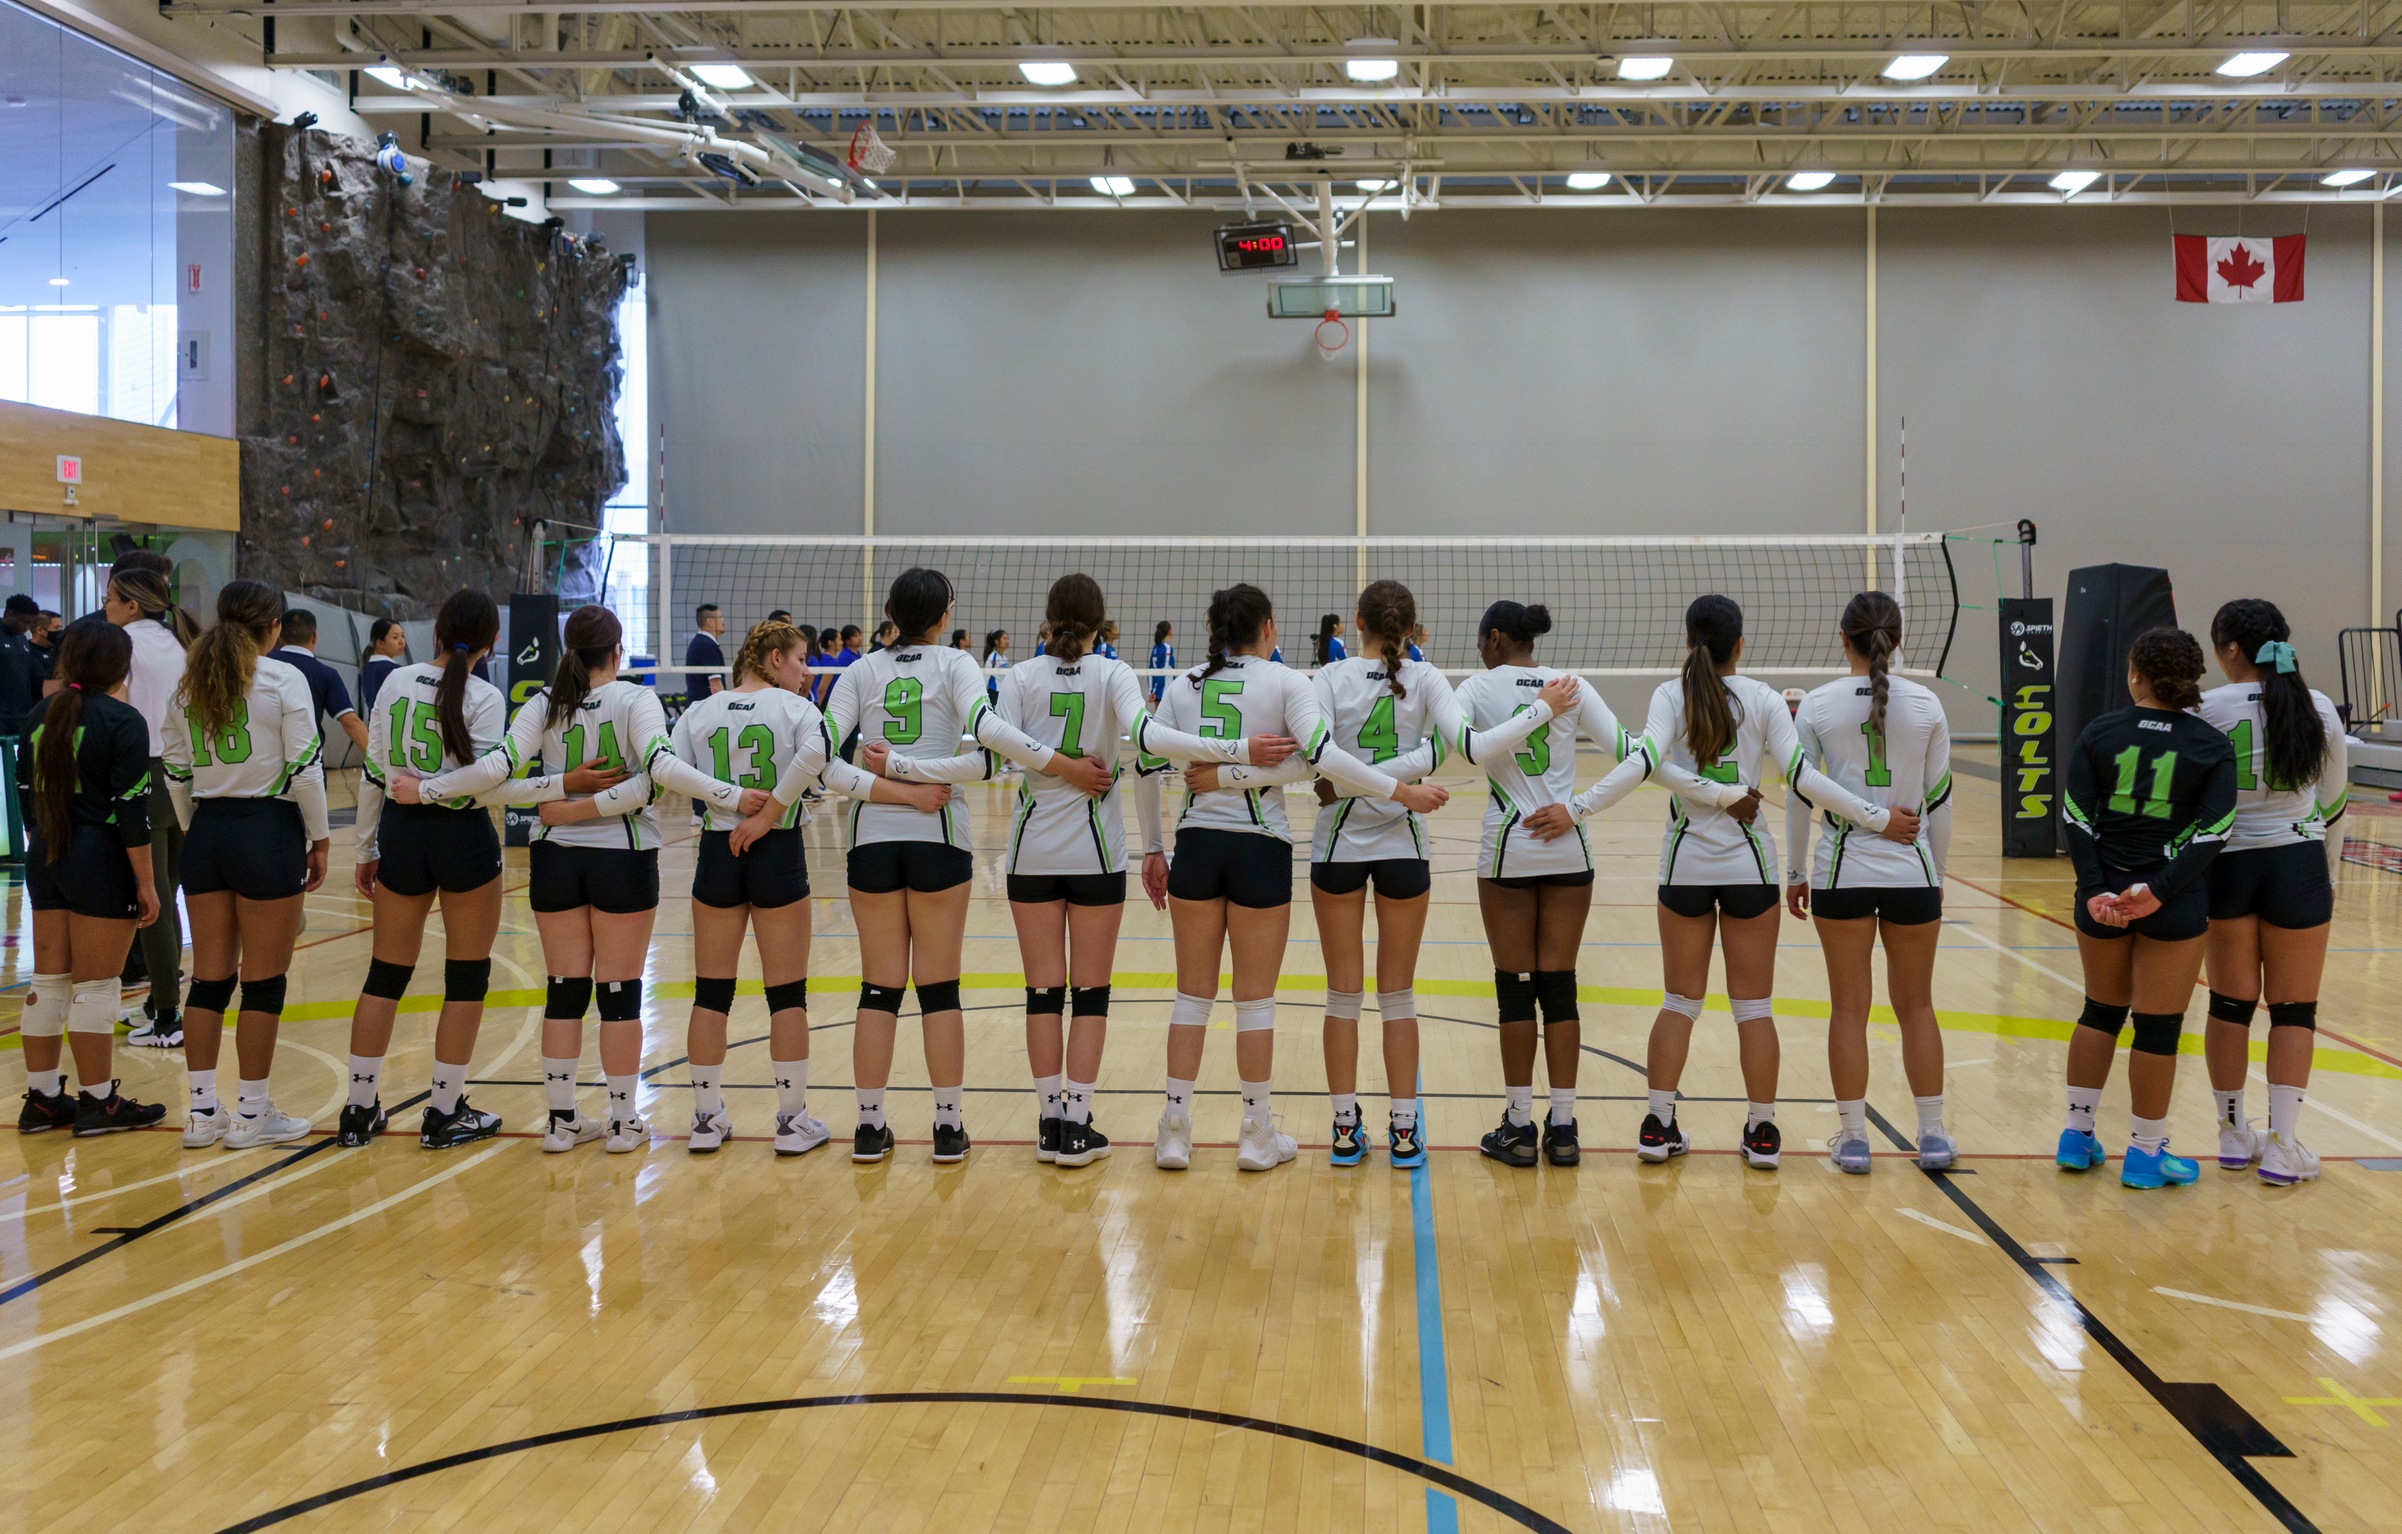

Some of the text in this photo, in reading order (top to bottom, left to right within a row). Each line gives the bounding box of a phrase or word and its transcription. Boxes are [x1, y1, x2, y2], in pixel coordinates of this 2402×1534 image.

[1239, 237, 1283, 252] 4:00
[63, 460, 76, 479] EXIT
[895, 653, 923, 663] OCAA
[1056, 666, 1082, 676] OCAA
[1516, 679, 1544, 688] OCAA
[1855, 687, 1874, 696] OC
[184, 696, 252, 767] 18
[389, 696, 443, 774] 15
[883, 676, 923, 745] 9
[1050, 692, 1085, 760] 7
[1199, 678, 1245, 741] 5
[1357, 695, 1398, 765] 4
[1512, 703, 1551, 777] 3
[2138, 719, 2173, 732] OCAA
[562, 720, 627, 777] 14
[708, 724, 777, 793] 13
[1861, 719, 1891, 787] 1
[2013, 685, 2052, 819] COLTS
[2108, 745, 2178, 819] 11
